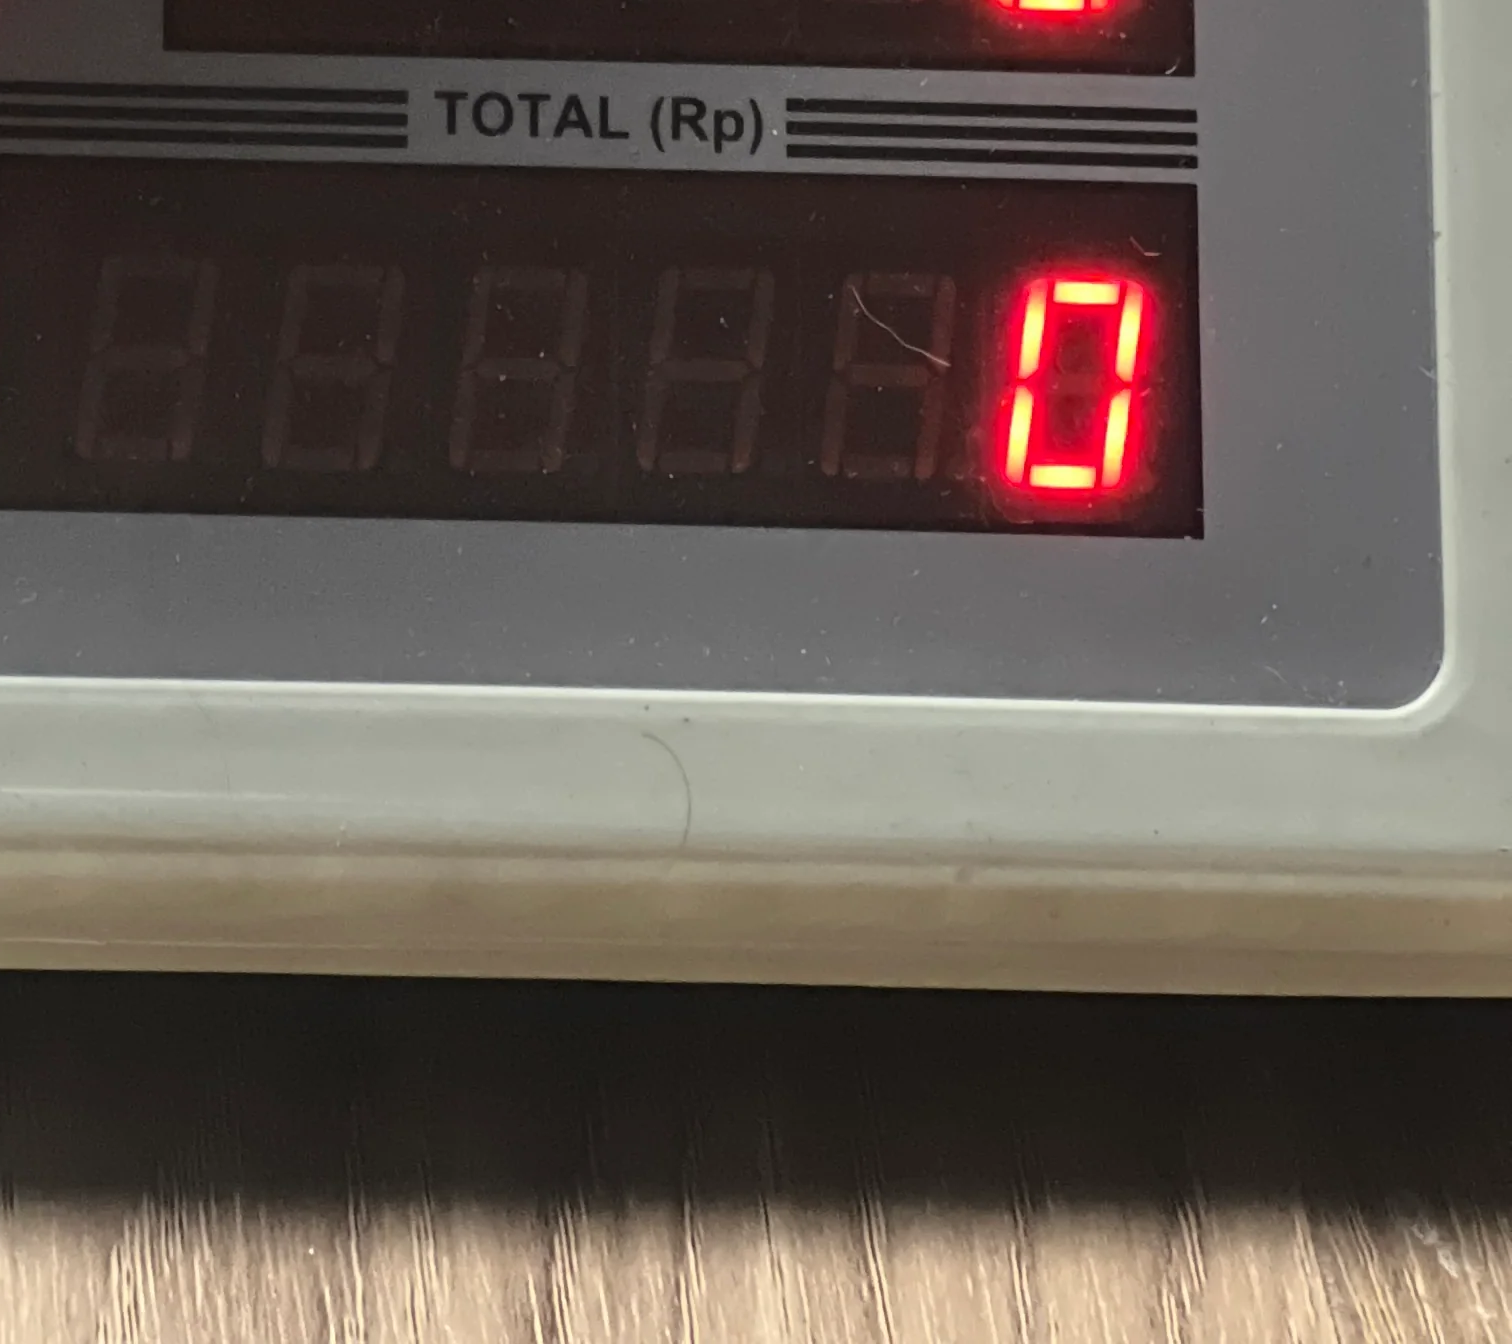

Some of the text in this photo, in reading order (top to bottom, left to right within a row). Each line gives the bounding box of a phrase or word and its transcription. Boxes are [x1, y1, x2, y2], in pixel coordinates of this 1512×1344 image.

[434, 90, 766, 153] TOTAL (Rp)
[1006, 280, 1145, 490] 0
